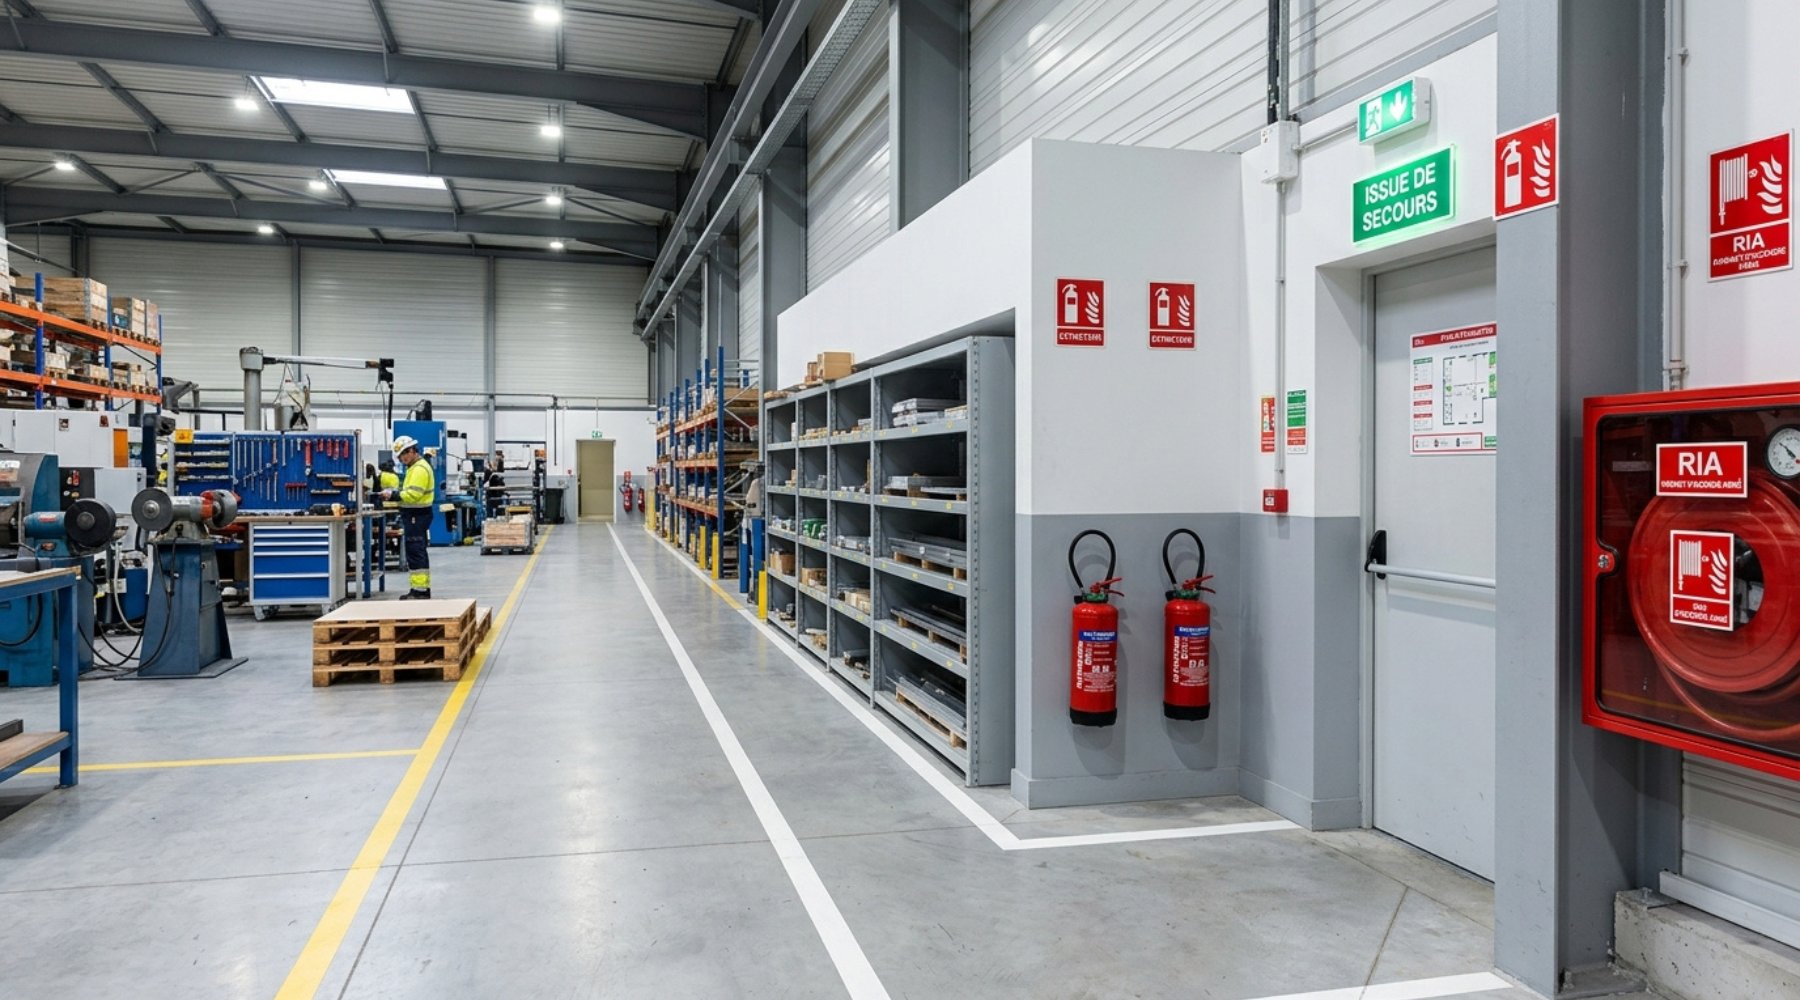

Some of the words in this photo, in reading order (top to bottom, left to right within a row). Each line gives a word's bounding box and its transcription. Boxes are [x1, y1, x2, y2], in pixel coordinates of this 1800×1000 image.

[1365, 171, 1410, 205] ISSUE
[1413, 161, 1436, 189] DE
[1362, 190, 1438, 231] SECOURS
[1733, 232, 1766, 252] RIA
[1678, 451, 1724, 476] RIA
